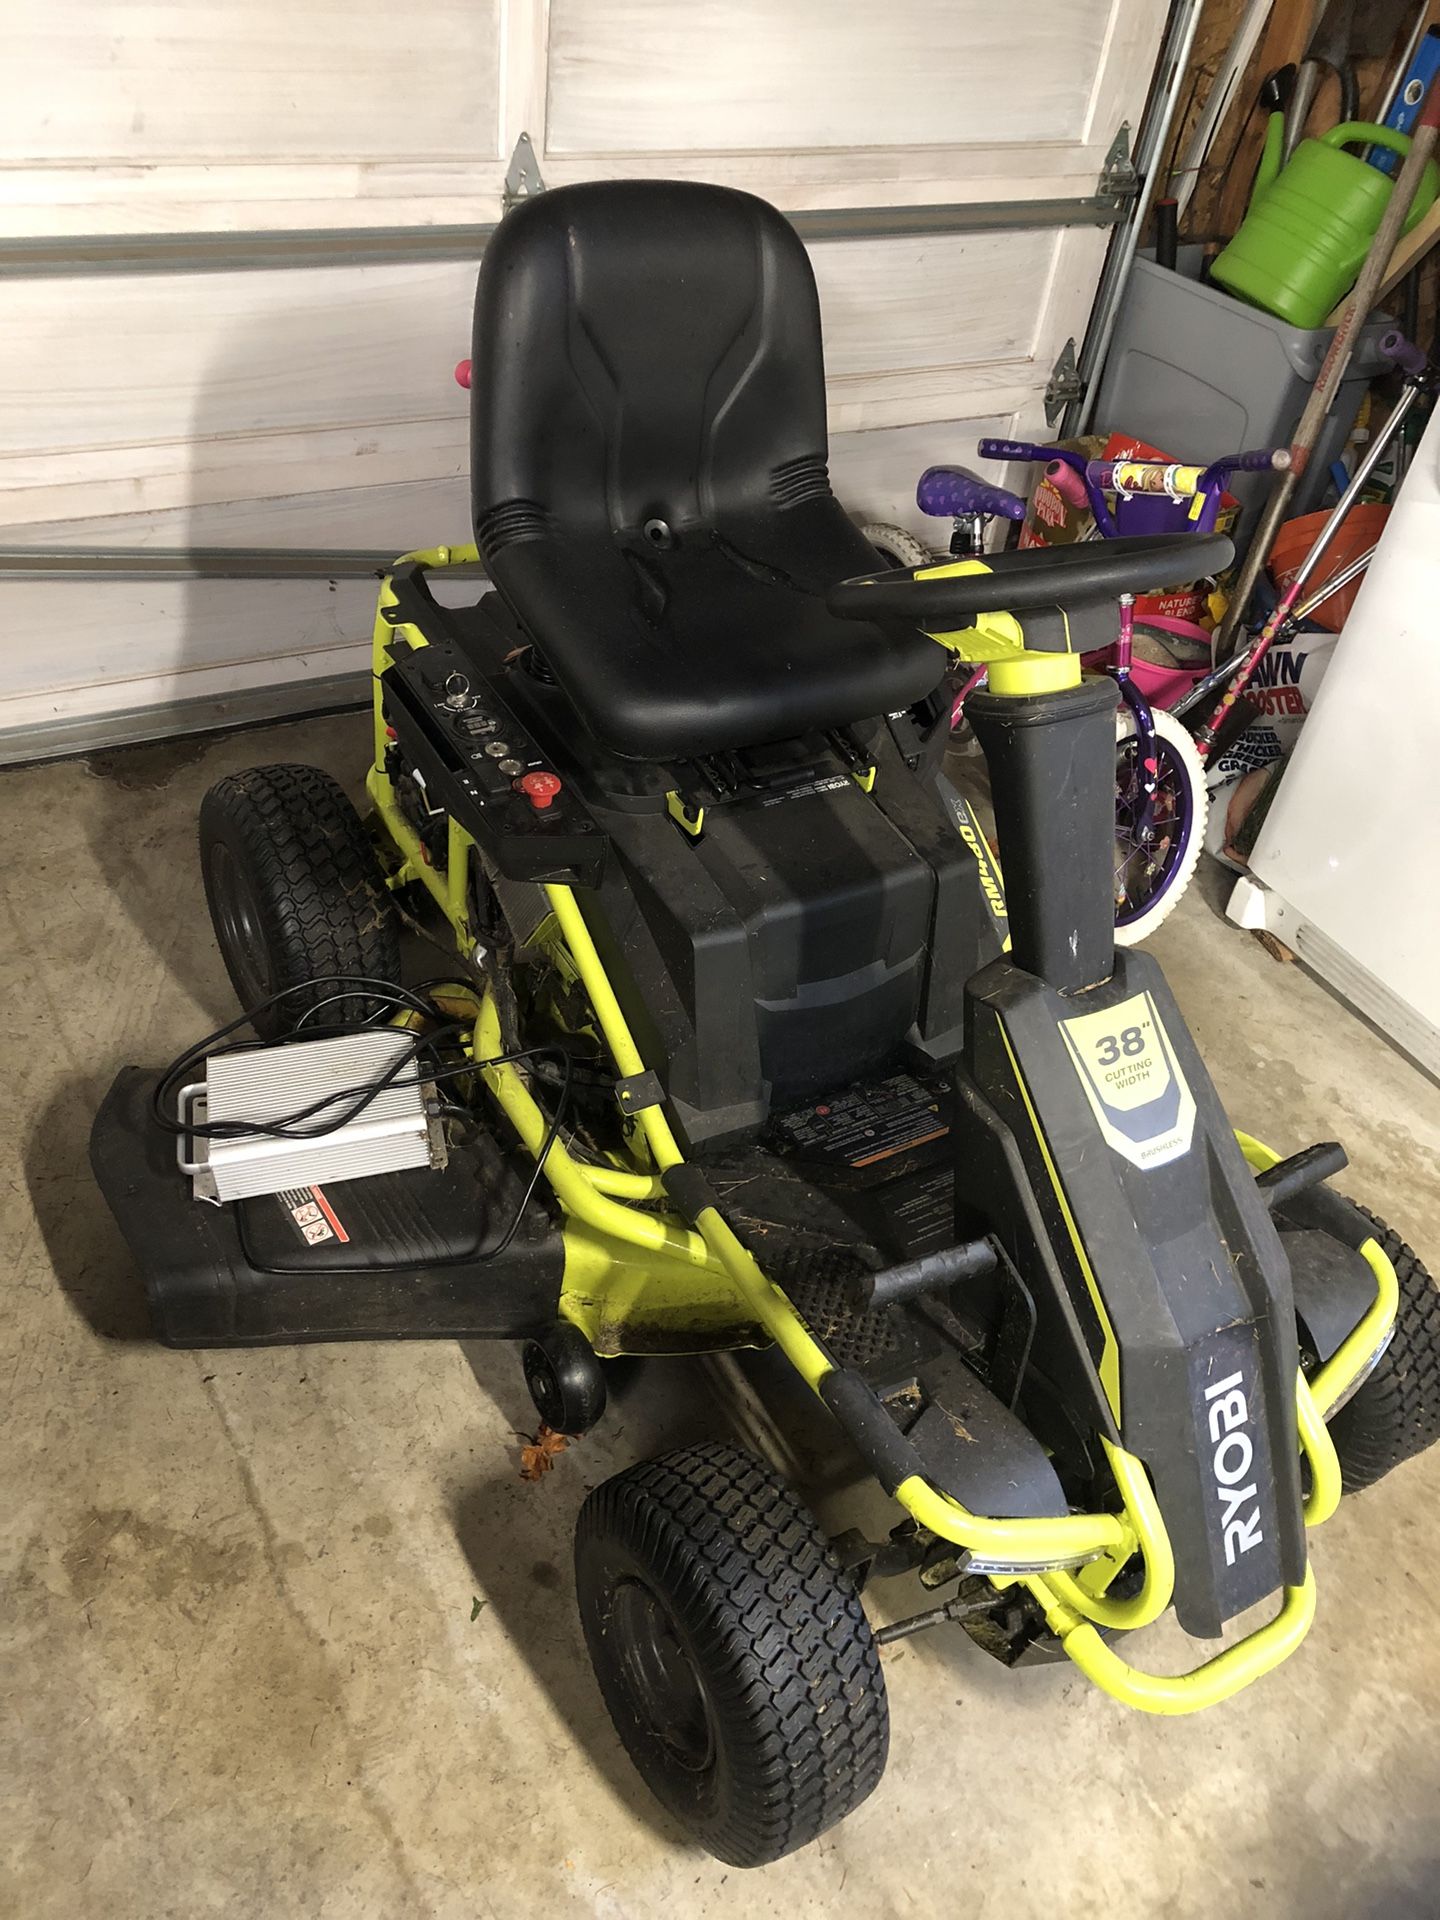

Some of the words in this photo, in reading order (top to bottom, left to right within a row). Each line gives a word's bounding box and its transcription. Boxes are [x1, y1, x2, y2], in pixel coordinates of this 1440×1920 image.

[1246, 651, 1309, 690] AWN
[1246, 686, 1309, 716] OOSTER
[1104, 1058, 1153, 1083] CUTTING
[1115, 1070, 1151, 1090] WIDTH
[1140, 1137, 1184, 1160] BRUSHLESS
[1204, 1370, 1264, 1567] RYOBI
